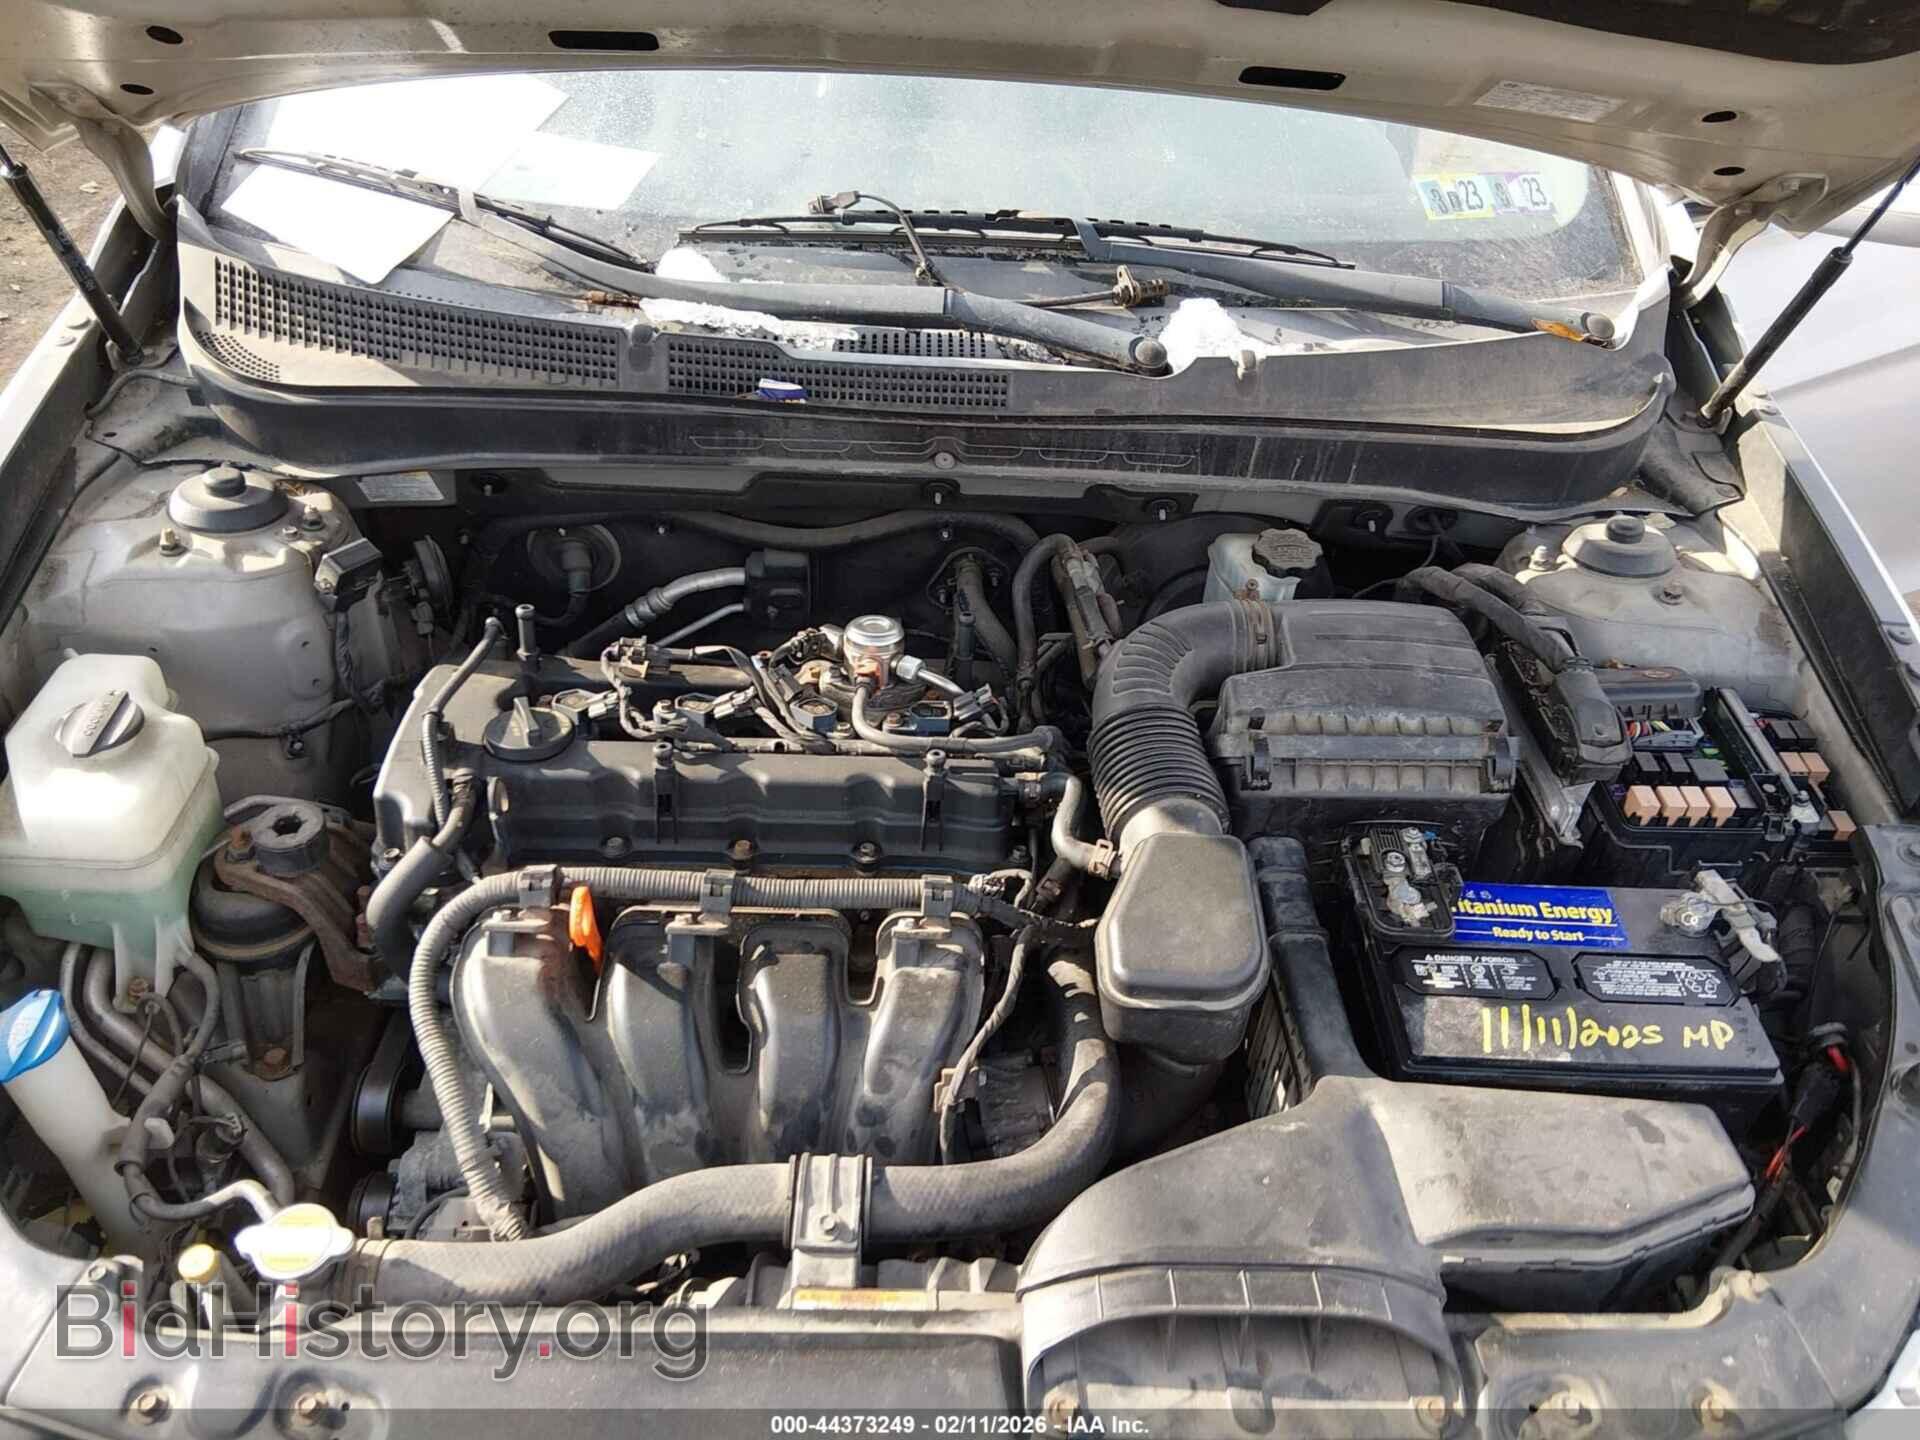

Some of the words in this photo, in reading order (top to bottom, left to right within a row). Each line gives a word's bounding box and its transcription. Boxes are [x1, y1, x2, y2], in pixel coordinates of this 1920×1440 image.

[1458, 180, 1484, 210] 23
[1522, 177, 1547, 206] 23
[1451, 898, 1538, 918] itanium
[1539, 902, 1613, 925] Energy
[1492, 926, 1533, 942] Ready
[1535, 929, 1550, 940] to
[1550, 930, 1585, 942] Start
